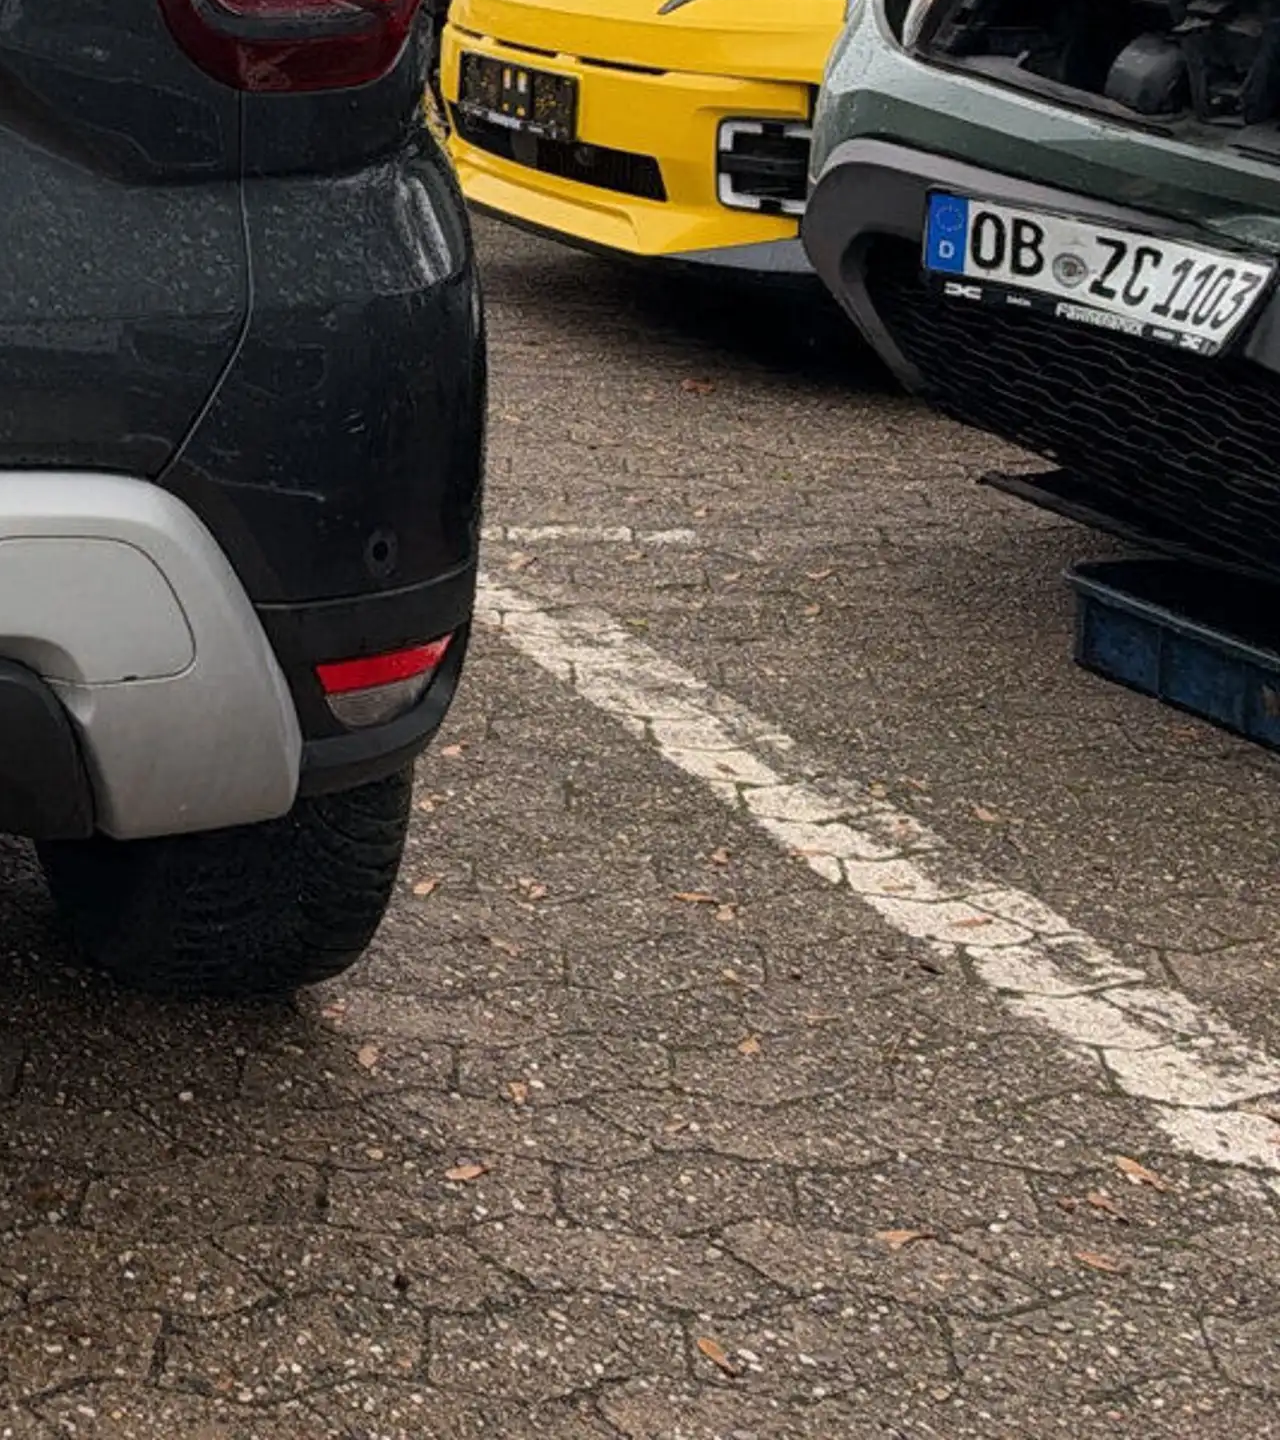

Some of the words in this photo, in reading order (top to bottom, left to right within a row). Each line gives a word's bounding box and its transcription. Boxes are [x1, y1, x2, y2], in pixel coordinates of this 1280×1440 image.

[939, 241, 955, 259] D
[970, 211, 1045, 277] OB
[1089, 236, 1164, 307] ZC
[1151, 258, 1262, 331] 1103
